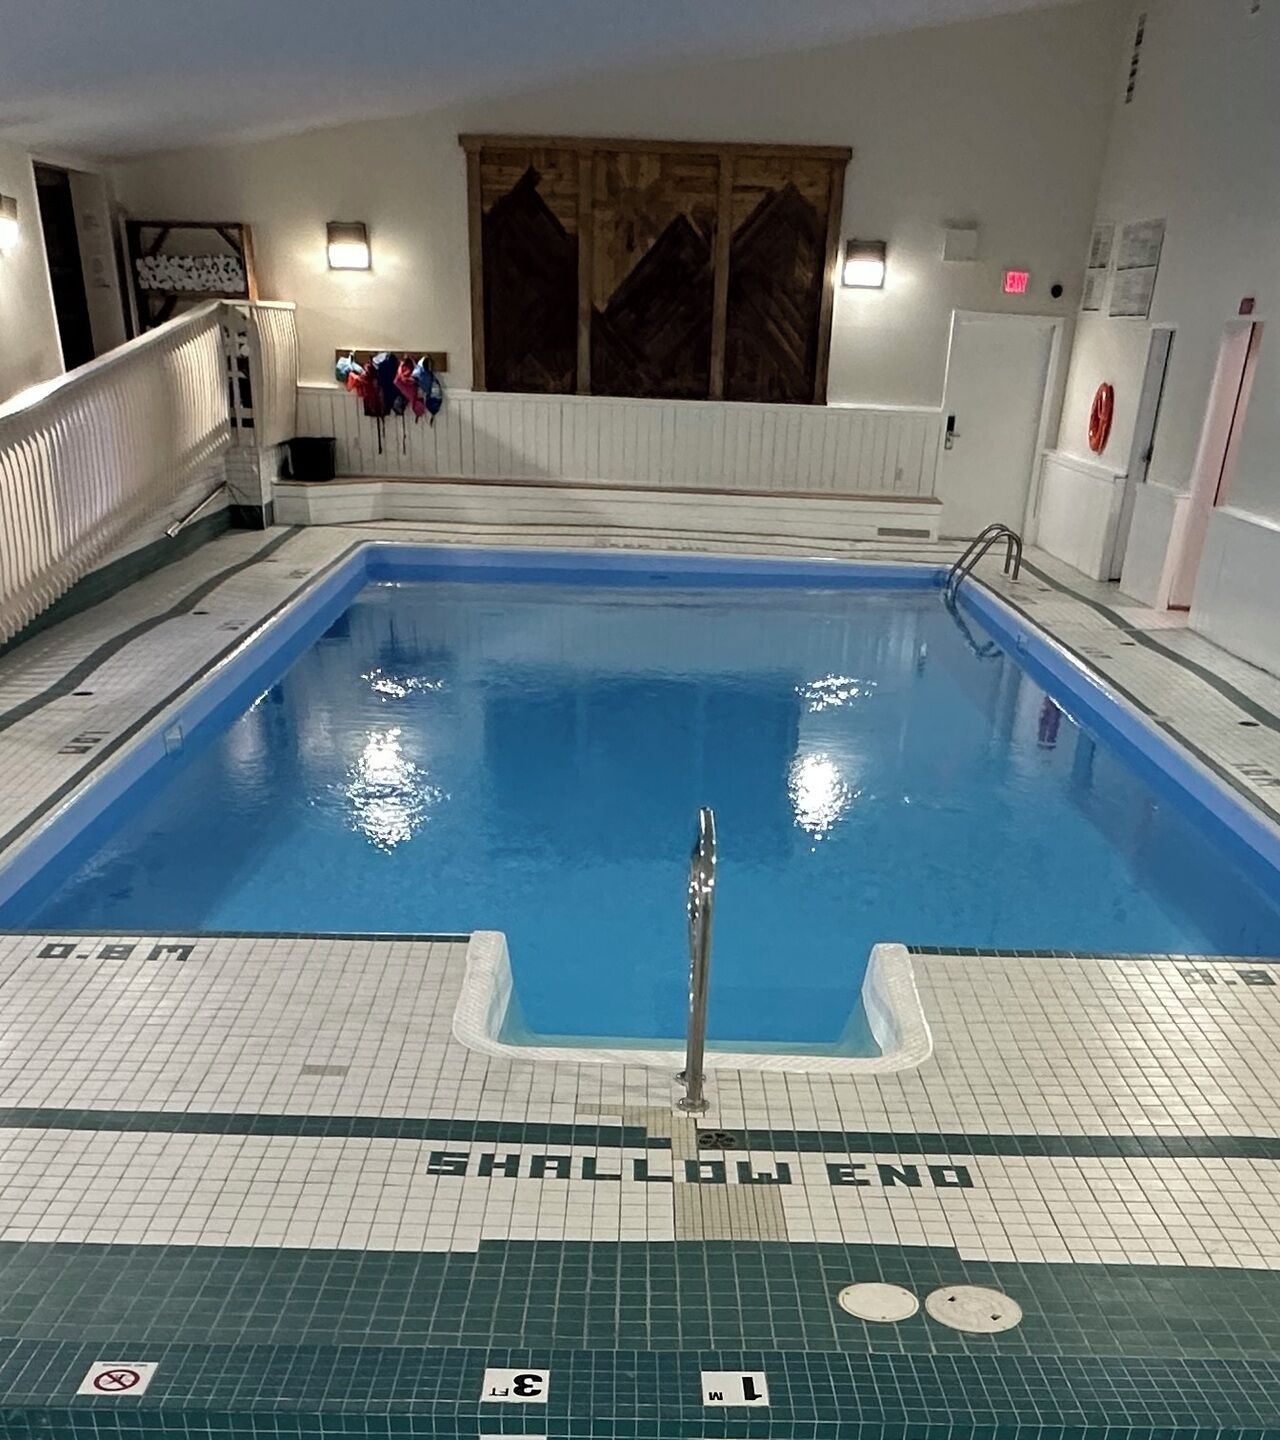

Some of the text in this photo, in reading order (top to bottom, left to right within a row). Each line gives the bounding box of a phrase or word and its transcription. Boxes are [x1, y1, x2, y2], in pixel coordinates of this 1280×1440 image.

[426, 1151, 974, 1188] SHALLOW END
[488, 1373, 543, 1397] 3 FT
[708, 1376, 762, 1401] 1 M
